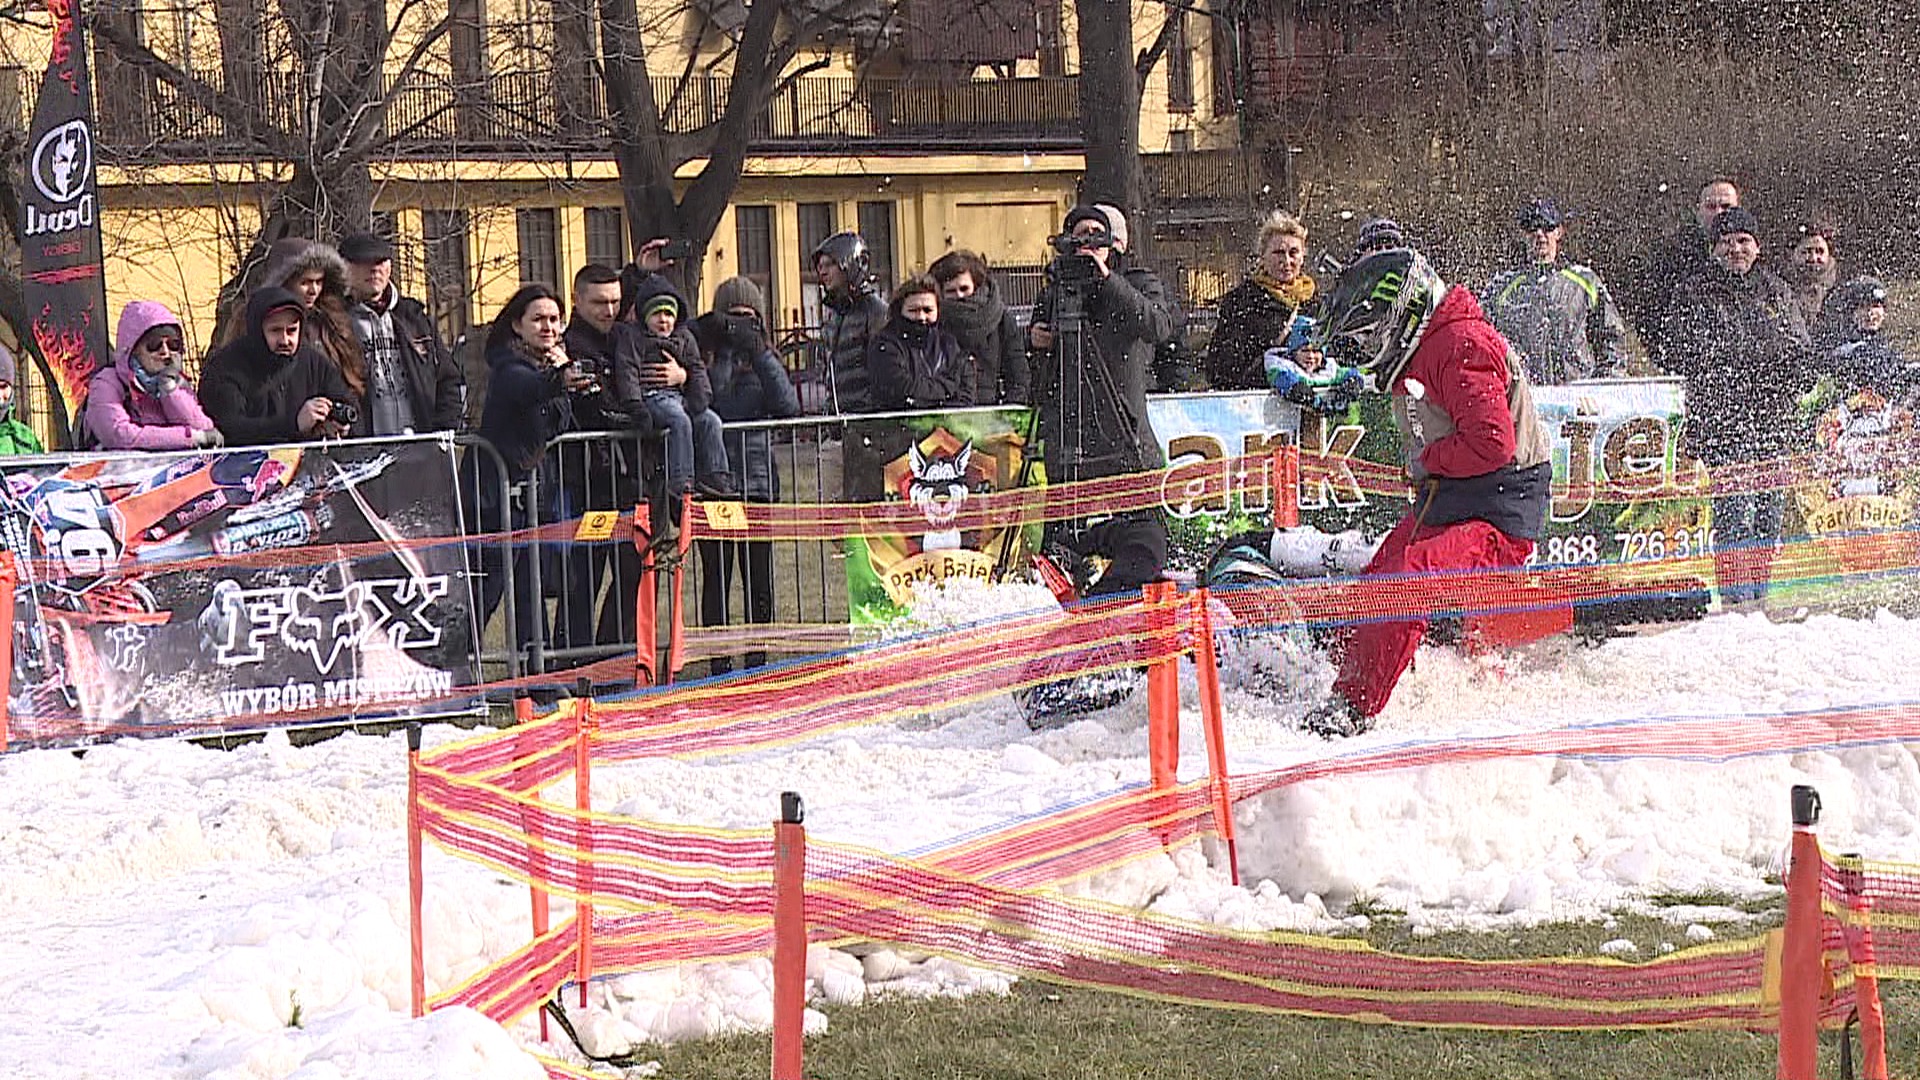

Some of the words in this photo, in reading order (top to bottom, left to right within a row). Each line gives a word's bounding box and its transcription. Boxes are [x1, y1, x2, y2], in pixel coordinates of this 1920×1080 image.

[1161, 426, 1366, 518] ark
[232, 527, 300, 553] DNLOP
[1547, 536, 1598, 565] 868
[1614, 531, 1665, 563] 726
[890, 559, 938, 589] Park
[221, 676, 318, 717] WYBÓR
